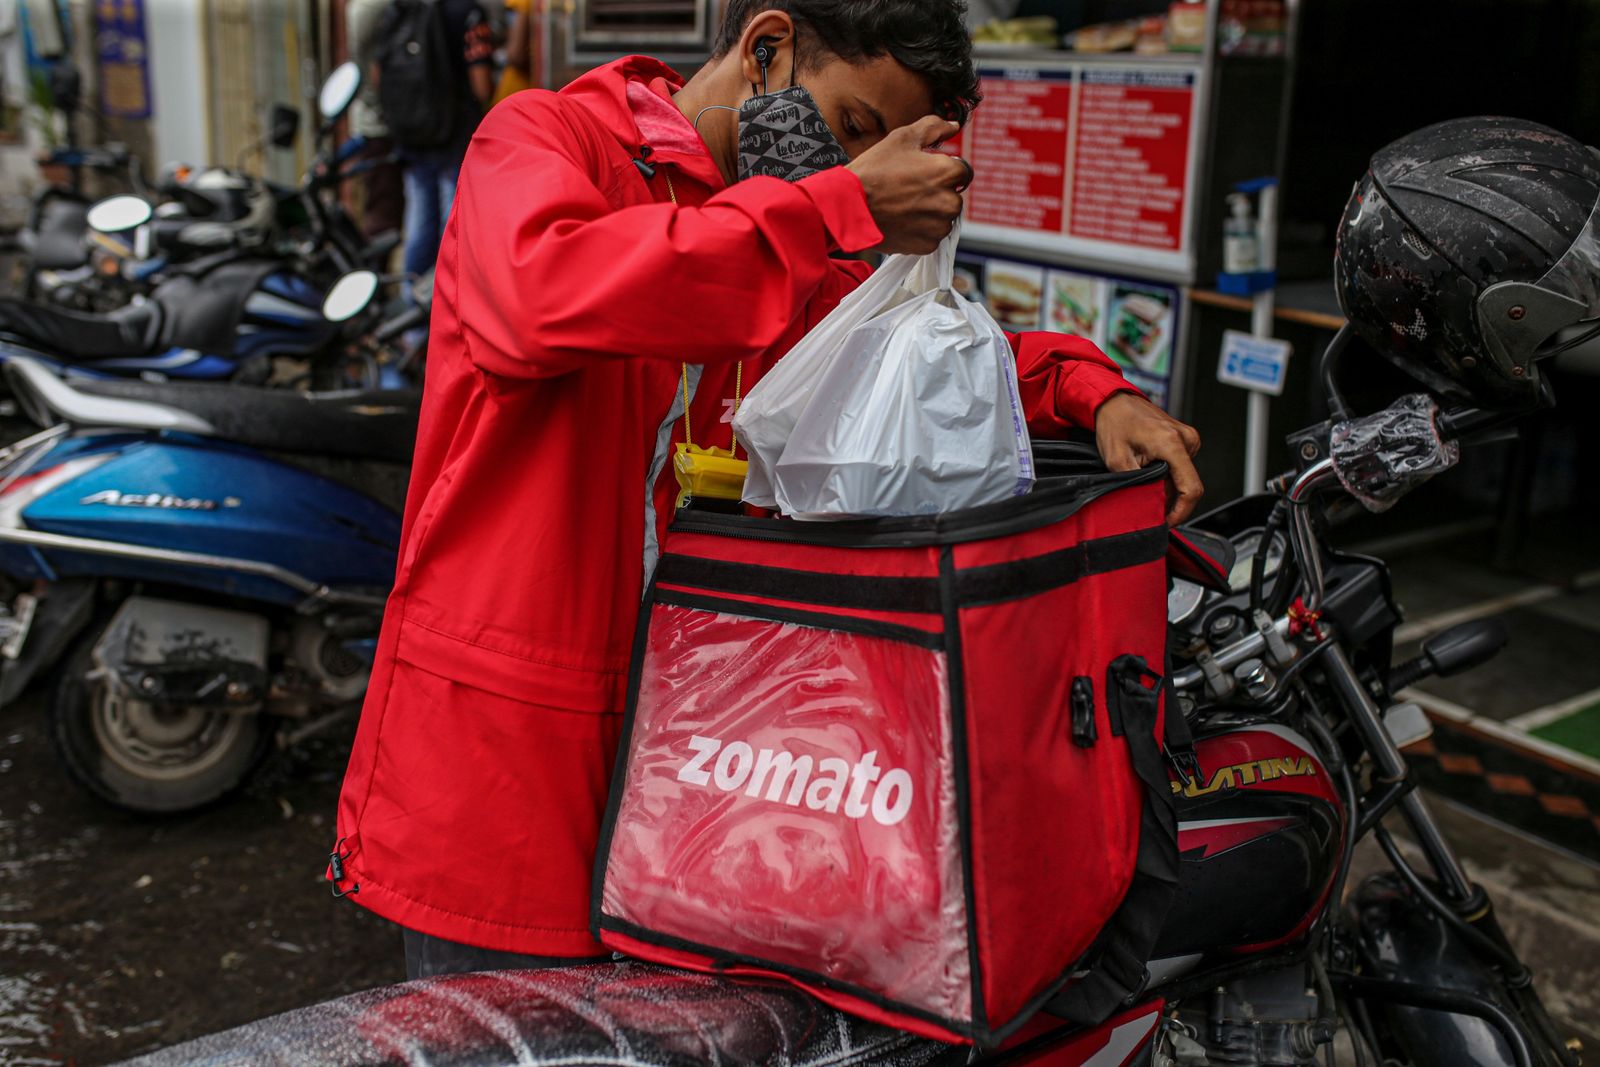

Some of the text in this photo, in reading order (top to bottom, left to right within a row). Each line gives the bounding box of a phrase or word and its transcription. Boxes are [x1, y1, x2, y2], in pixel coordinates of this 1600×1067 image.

[800, 121, 813, 135] Lee
[776, 141, 815, 157] Lee Cooper
[676, 734, 914, 826] zomato
